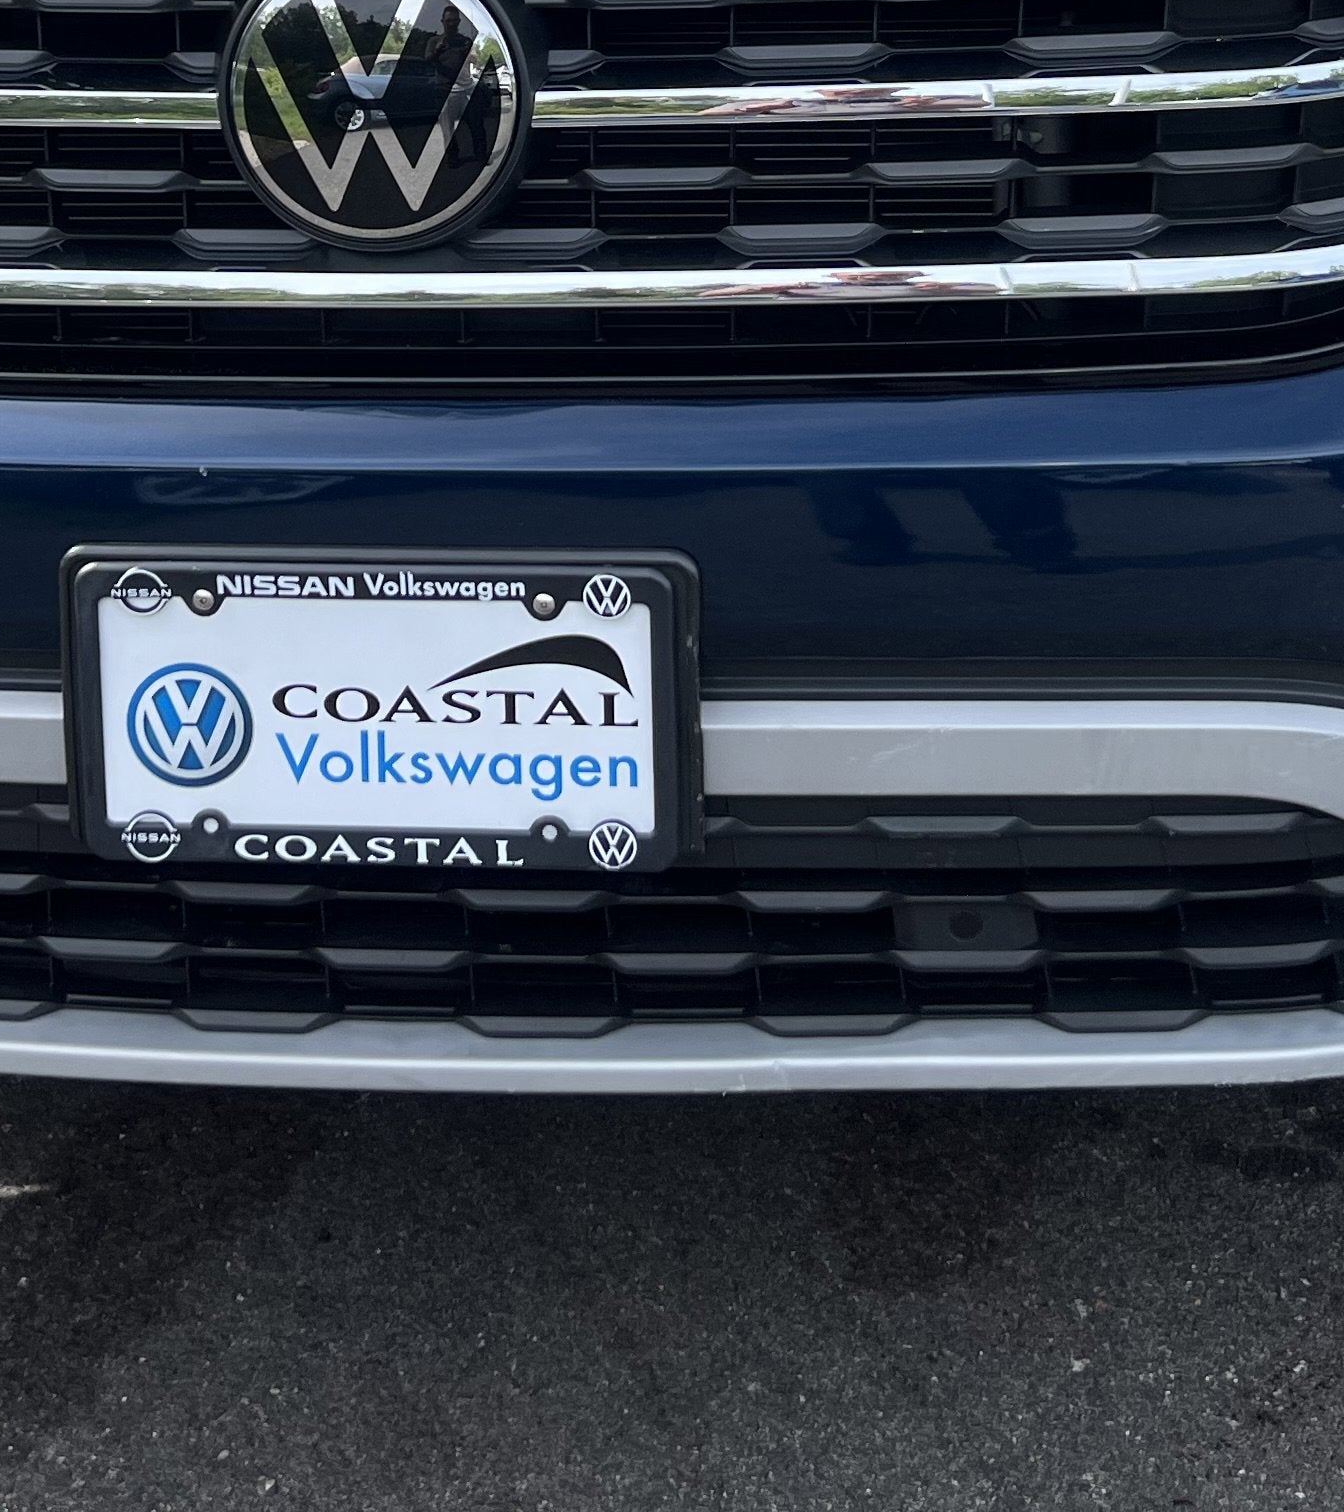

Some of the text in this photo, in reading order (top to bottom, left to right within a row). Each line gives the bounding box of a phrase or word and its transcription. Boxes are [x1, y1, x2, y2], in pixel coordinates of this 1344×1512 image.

[110, 588, 172, 598] NISSAN
[216, 571, 526, 601] NISSAN Volkswagen
[584, 575, 630, 617] VW
[130, 666, 251, 783] VW
[272, 683, 639, 727] COASTAL
[275, 729, 638, 801] Volkswagen
[121, 832, 181, 843] NISSAN
[234, 834, 524, 866] COASTAL
[590, 824, 636, 868] VW
